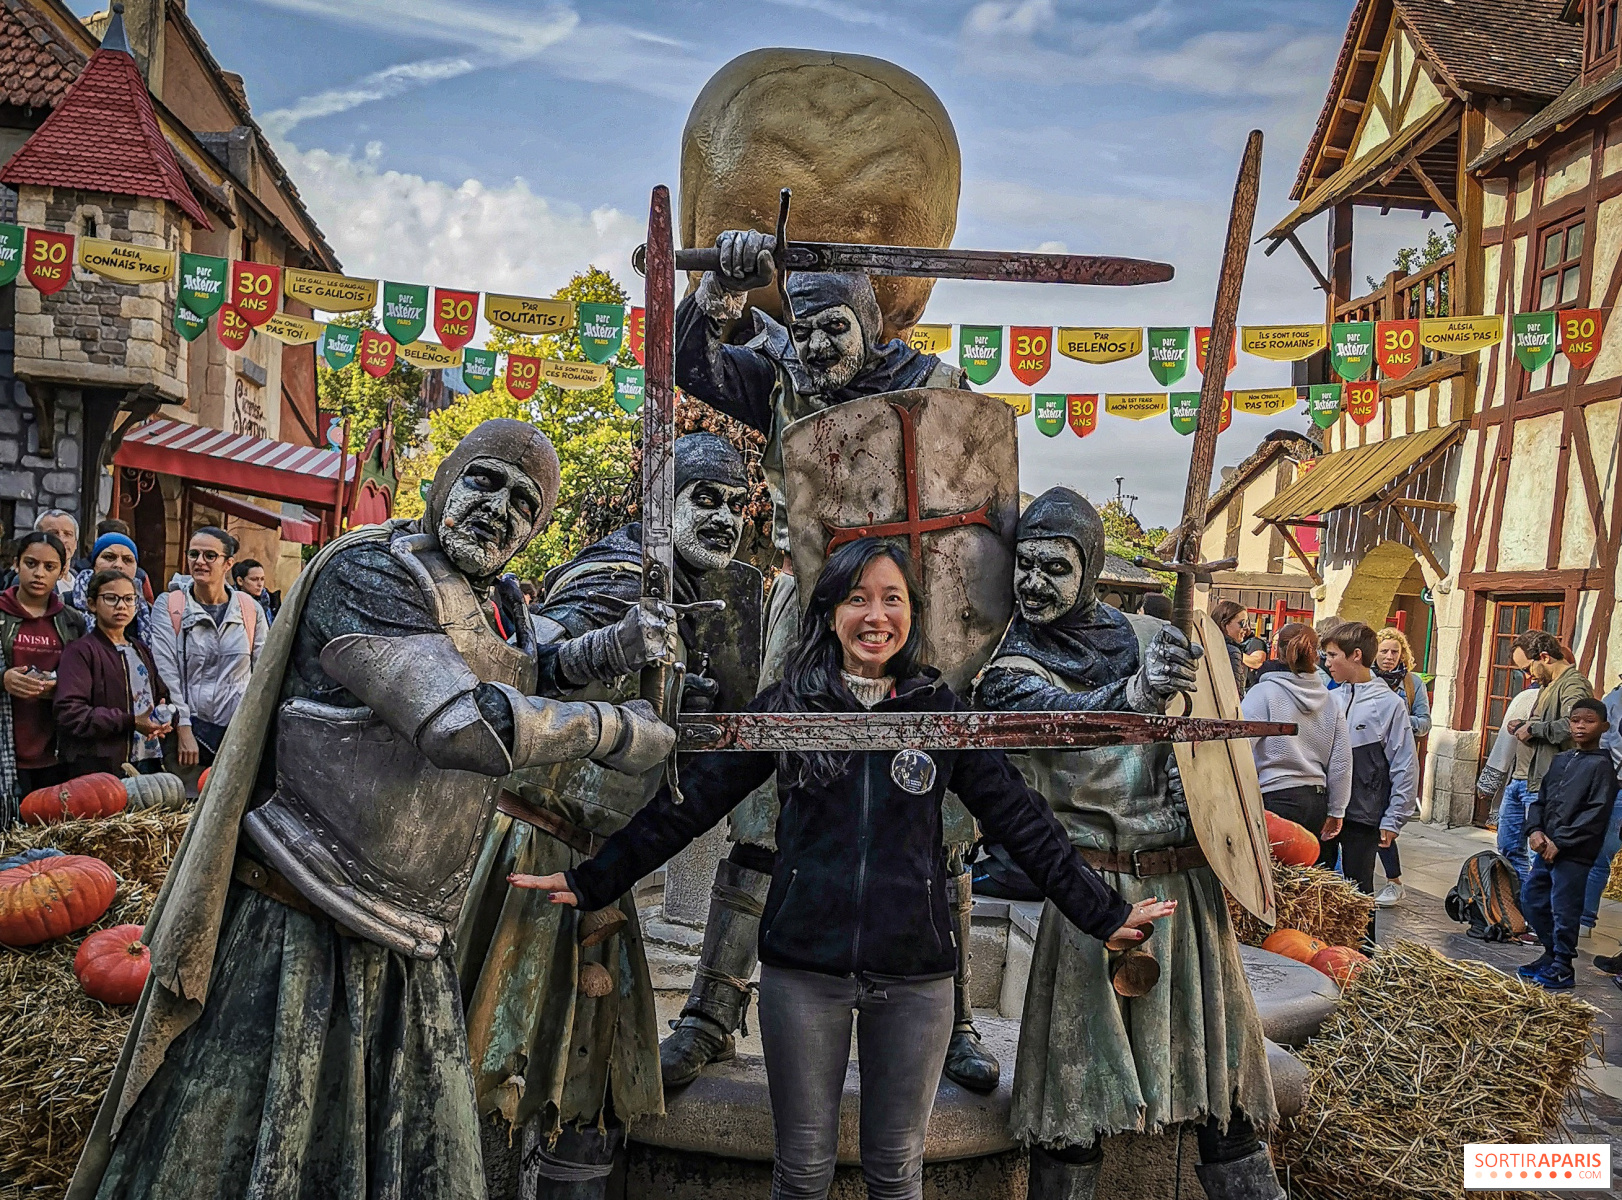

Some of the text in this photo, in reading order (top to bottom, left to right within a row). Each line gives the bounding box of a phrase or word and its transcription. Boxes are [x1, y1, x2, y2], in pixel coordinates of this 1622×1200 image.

[32, 240, 67, 264] 30
[85, 255, 137, 270] CONNAIS
[139, 263, 160, 274] PAS
[32, 265, 61, 279] ANS
[184, 274, 222, 293] Astérix
[238, 272, 272, 296] 30
[293, 284, 312, 294] LES
[315, 287, 364, 300] GAULOIS
[240, 298, 268, 311] ANS
[386, 302, 424, 320] Astérix
[440, 298, 473, 321] 30
[493, 310, 557, 326] TOUTATIS
[223, 329, 244, 340] ANS
[266, 325, 284, 334] PAS
[287, 329, 303, 339] TOI
[441, 325, 469, 336] ANS
[583, 322, 621, 339] Astérix
[1566, 318, 1595, 340] 30
[1248, 341, 1267, 349] CES
[1269, 339, 1314, 348] ROMAINS
[1384, 330, 1414, 350] 30
[1425, 333, 1470, 343] CONNAIS
[1473, 332, 1492, 340] PAS
[1517, 332, 1550, 347] Astérix
[366, 339, 392, 356] 30
[963, 344, 999, 359] Astérix
[1016, 336, 1047, 356] 30
[1068, 342, 1127, 353] BELENOS
[1336, 342, 1370, 356] Astérix
[1568, 343, 1593, 353] ANS
[404, 349, 450, 364] BELENOS
[1152, 347, 1186, 361] Astérix
[1386, 353, 1412, 364] ANS
[366, 357, 388, 367] ANS
[1017, 360, 1044, 370] ANS
[511, 362, 536, 379] 30
[562, 372, 597, 382] ROMAINS
[511, 380, 532, 390] ANS
[1351, 388, 1374, 405] 30
[1071, 401, 1094, 416] 30
[1264, 400, 1279, 408] TOI
[1353, 406, 1372, 415] ANS
[1073, 418, 1092, 427] ANS
